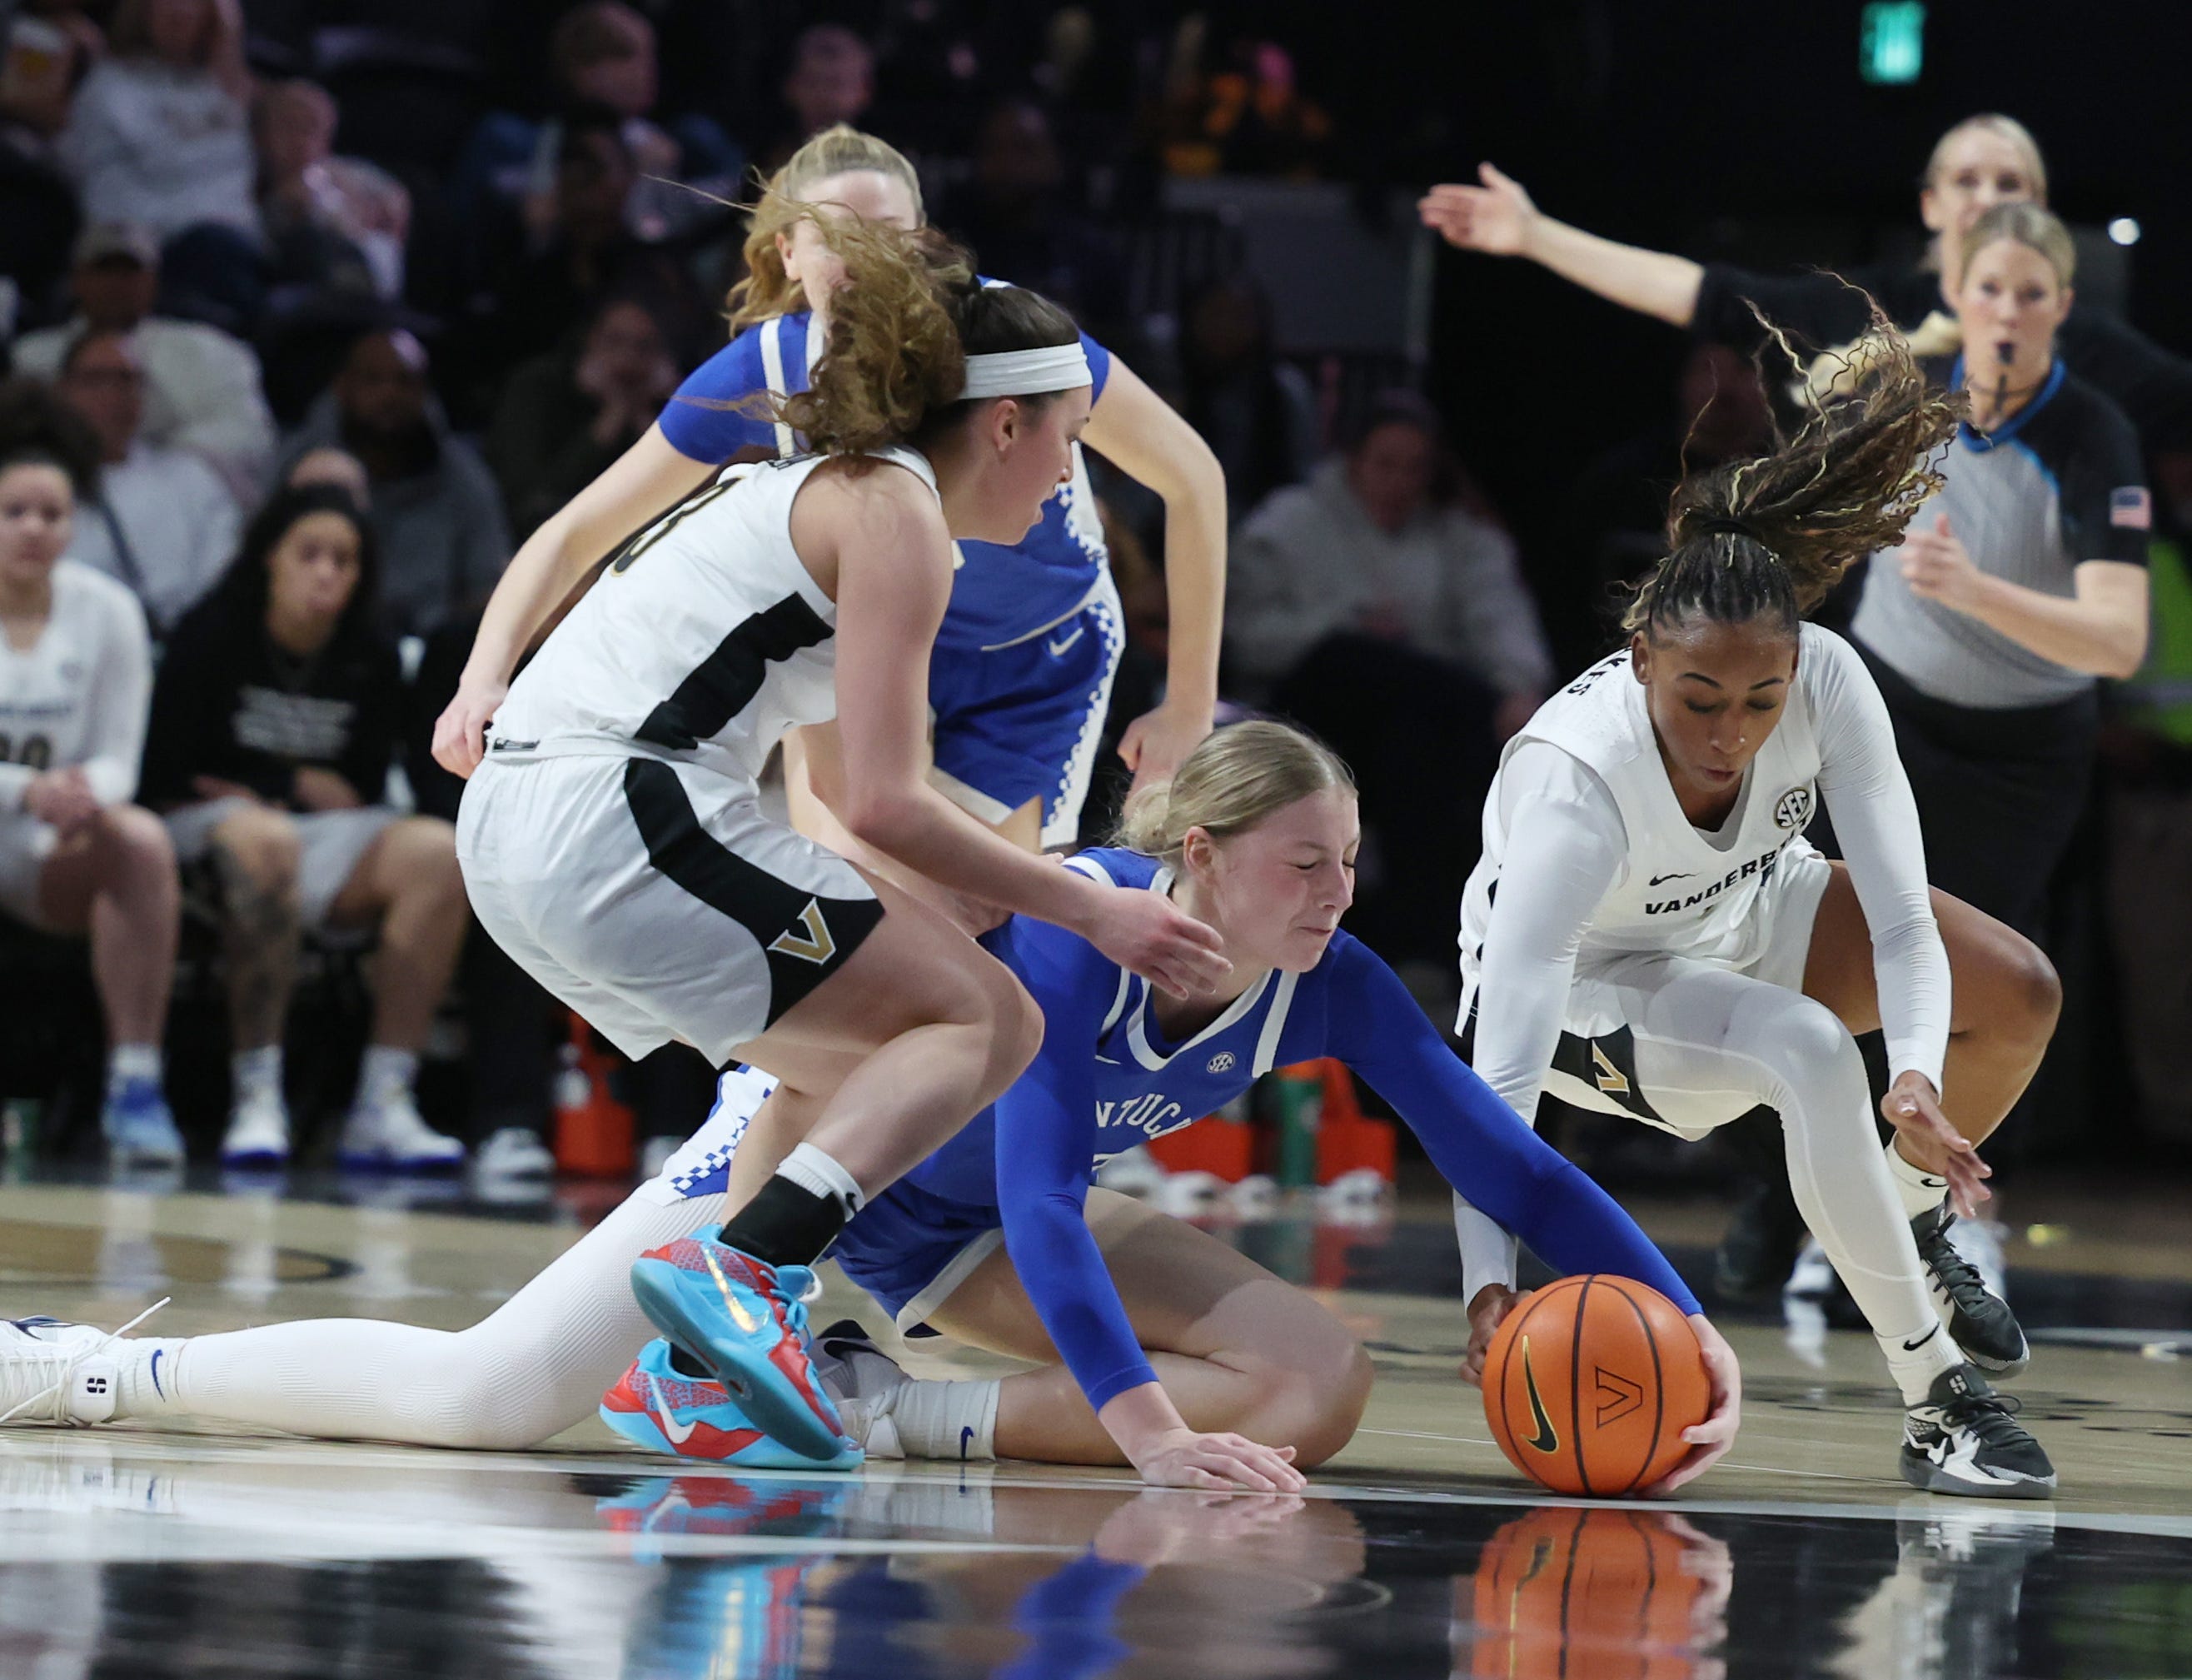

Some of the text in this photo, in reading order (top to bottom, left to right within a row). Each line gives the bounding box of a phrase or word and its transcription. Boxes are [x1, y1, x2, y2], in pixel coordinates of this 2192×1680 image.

[1776, 789, 1809, 828] SEC
[767, 896, 836, 965] V
[1208, 1052, 1234, 1073] SEC
[1595, 1366, 1643, 1428] V
